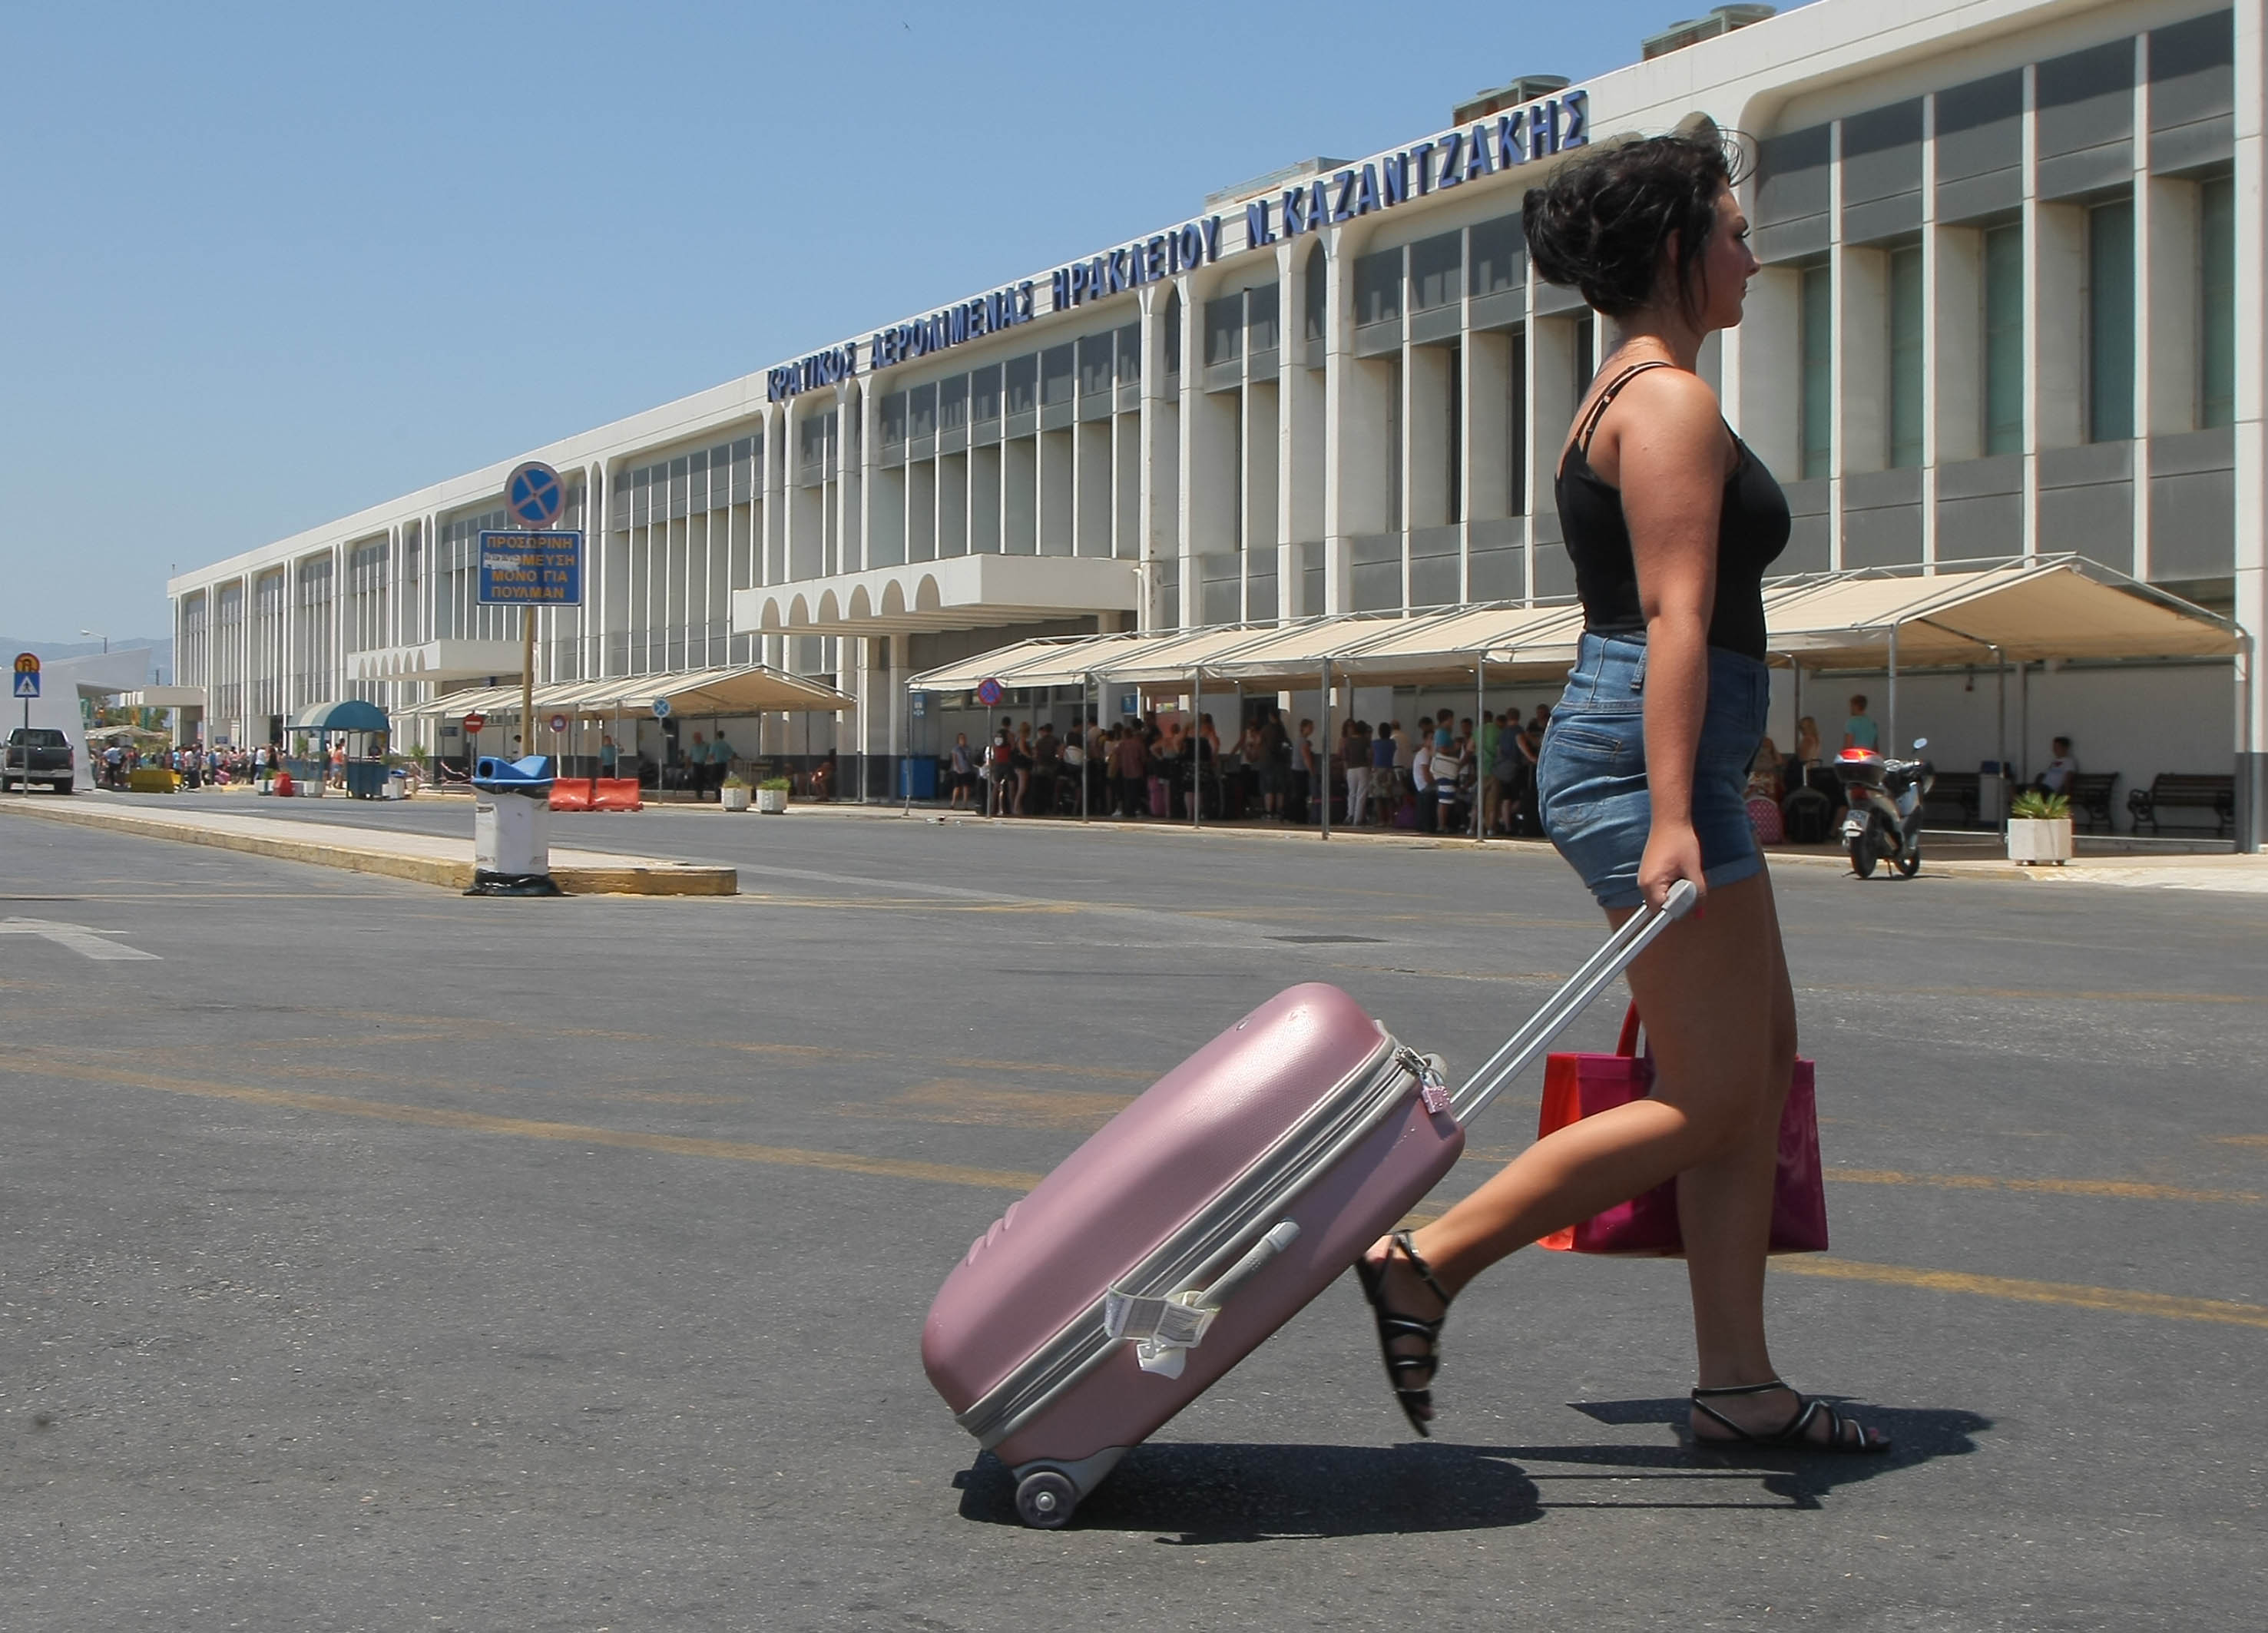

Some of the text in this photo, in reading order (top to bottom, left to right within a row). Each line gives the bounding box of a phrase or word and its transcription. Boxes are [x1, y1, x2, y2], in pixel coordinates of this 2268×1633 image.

[768, 342, 856, 402] ΚΡΑΤΙΚΟΣ
[871, 280, 1034, 369] ΑΕΡΟΛΙΜΕΝΑΣ
[1052, 216, 1220, 311] ΗΡΑΚΛΕΙΟΥ
[487, 536, 573, 549] ΠΡΟΣΩΡΙΝΗ
[484, 553, 575, 566] ΜΕΥΣΗ
[492, 570, 568, 583] ΜΟΝΟ ΓΙΑ
[492, 585, 565, 598] ΠΟΥΛΜΑΝ
